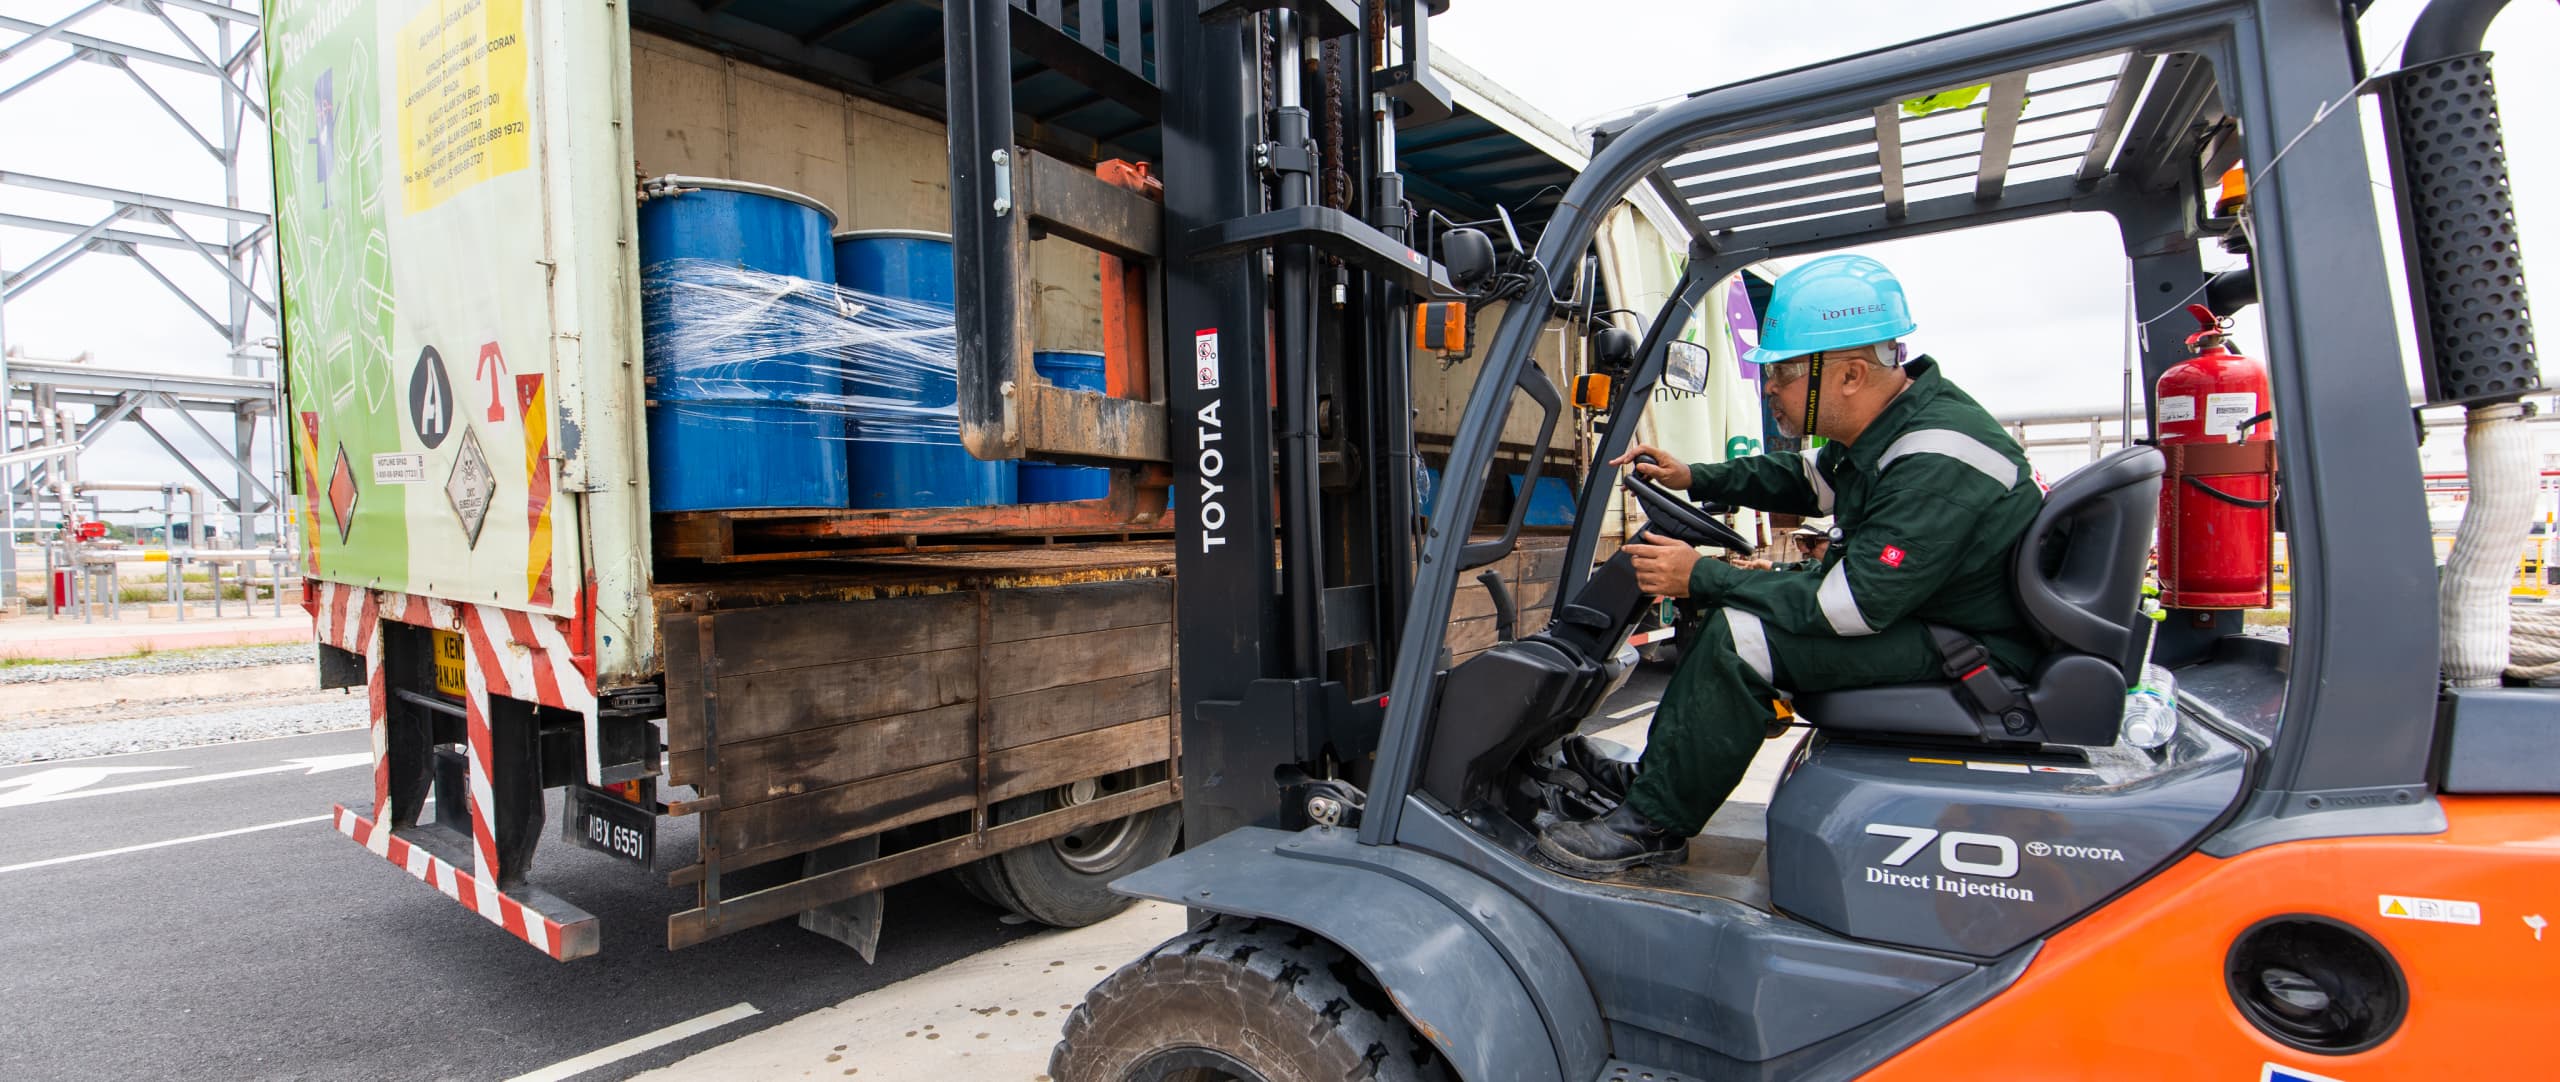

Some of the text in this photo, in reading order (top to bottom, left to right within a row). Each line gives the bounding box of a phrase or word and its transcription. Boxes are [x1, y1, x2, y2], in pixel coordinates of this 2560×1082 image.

[467, 84, 481, 100] BHD
[503, 121, 524, 136] 1972)
[1823, 306, 1866, 321] LOTTE
[422, 357, 444, 435] A
[476, 341, 507, 423] T
[1198, 398, 1226, 553] TOYOTA
[589, 814, 643, 860] NBX 6551
[1865, 823, 2020, 878] 70
[2053, 844, 2125, 862] TOYOTA
[1866, 866, 2034, 902] Direct Injection
